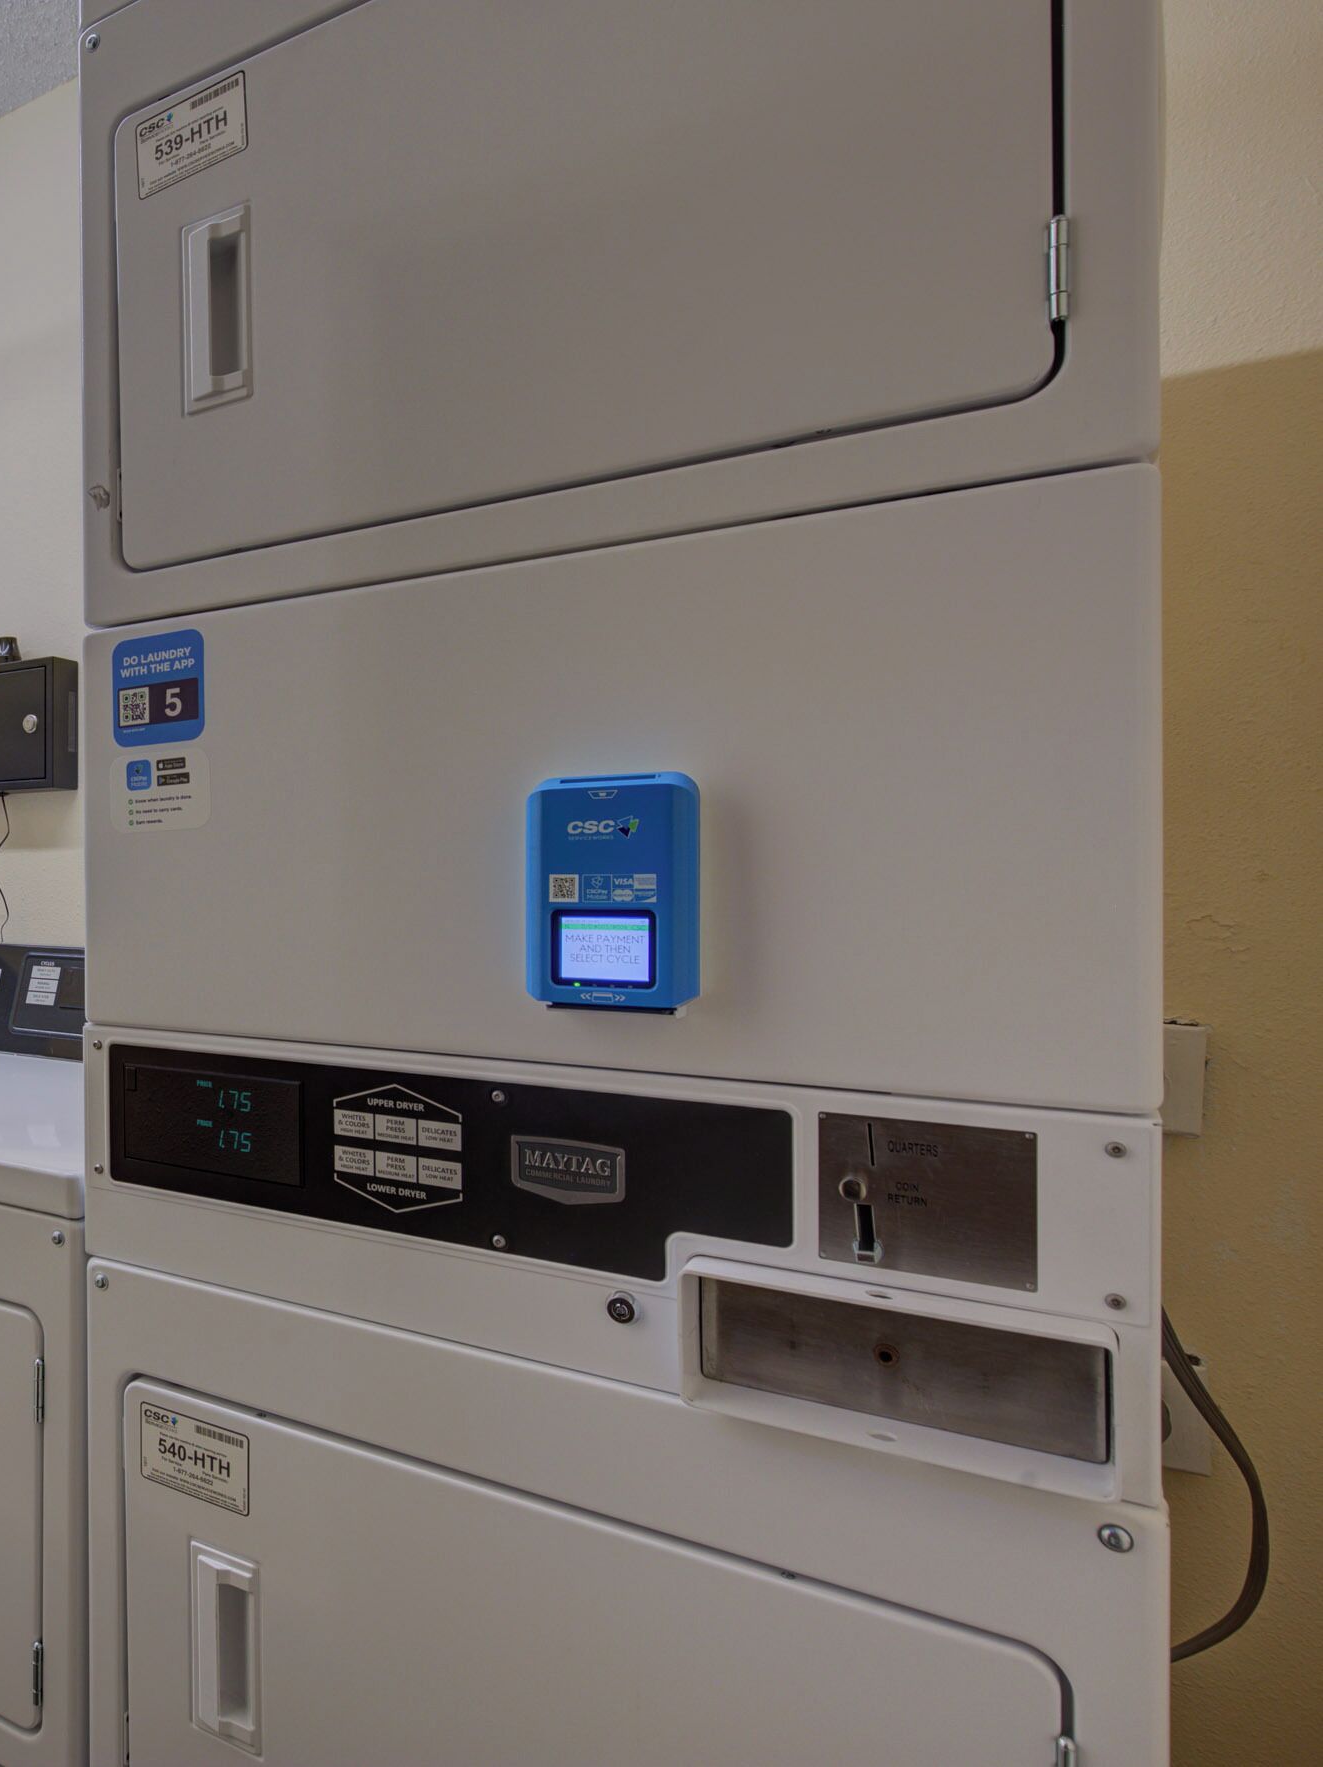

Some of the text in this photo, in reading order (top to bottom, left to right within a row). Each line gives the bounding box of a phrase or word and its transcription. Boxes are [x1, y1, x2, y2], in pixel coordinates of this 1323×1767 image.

[139, 118, 165, 138] CSC
[155, 110, 228, 161] 539-HTH
[123, 647, 191, 666] DO LAUNDRY
[120, 658, 195, 678] WITH THE APP
[164, 688, 182, 717] 5
[567, 820, 615, 834] CSC
[613, 878, 634, 886] VISA
[565, 934, 645, 944] MAKE PAYMENT
[579, 944, 631, 954] AND THEN
[570, 953, 641, 965] SELECT CYCLE
[367, 1098, 425, 1112] UPPER DRYER
[341, 1113, 366, 1121] WHITES
[386, 1119, 405, 1127] PERM
[345, 1120, 370, 1129] COLORS
[386, 1125, 406, 1134] PRESS
[421, 1126, 457, 1137] DELICATES
[342, 1149, 366, 1158] WHITES
[887, 1140, 939, 1157] QUARTERS
[345, 1157, 370, 1166] COLORS
[386, 1156, 405, 1164] PERM
[524, 1149, 611, 1176] MAYTAG
[386, 1162, 406, 1171] PRESS
[421, 1164, 457, 1175] DELICATES
[525, 1168, 612, 1187] COMMERCIAL LAUNDRY
[367, 1183, 427, 1200] LOWER DRYER
[895, 1181, 919, 1193] COIN
[887, 1193, 927, 1207] RETURN
[144, 1409, 169, 1423] CSC
[158, 1437, 230, 1478] 540-HTH
